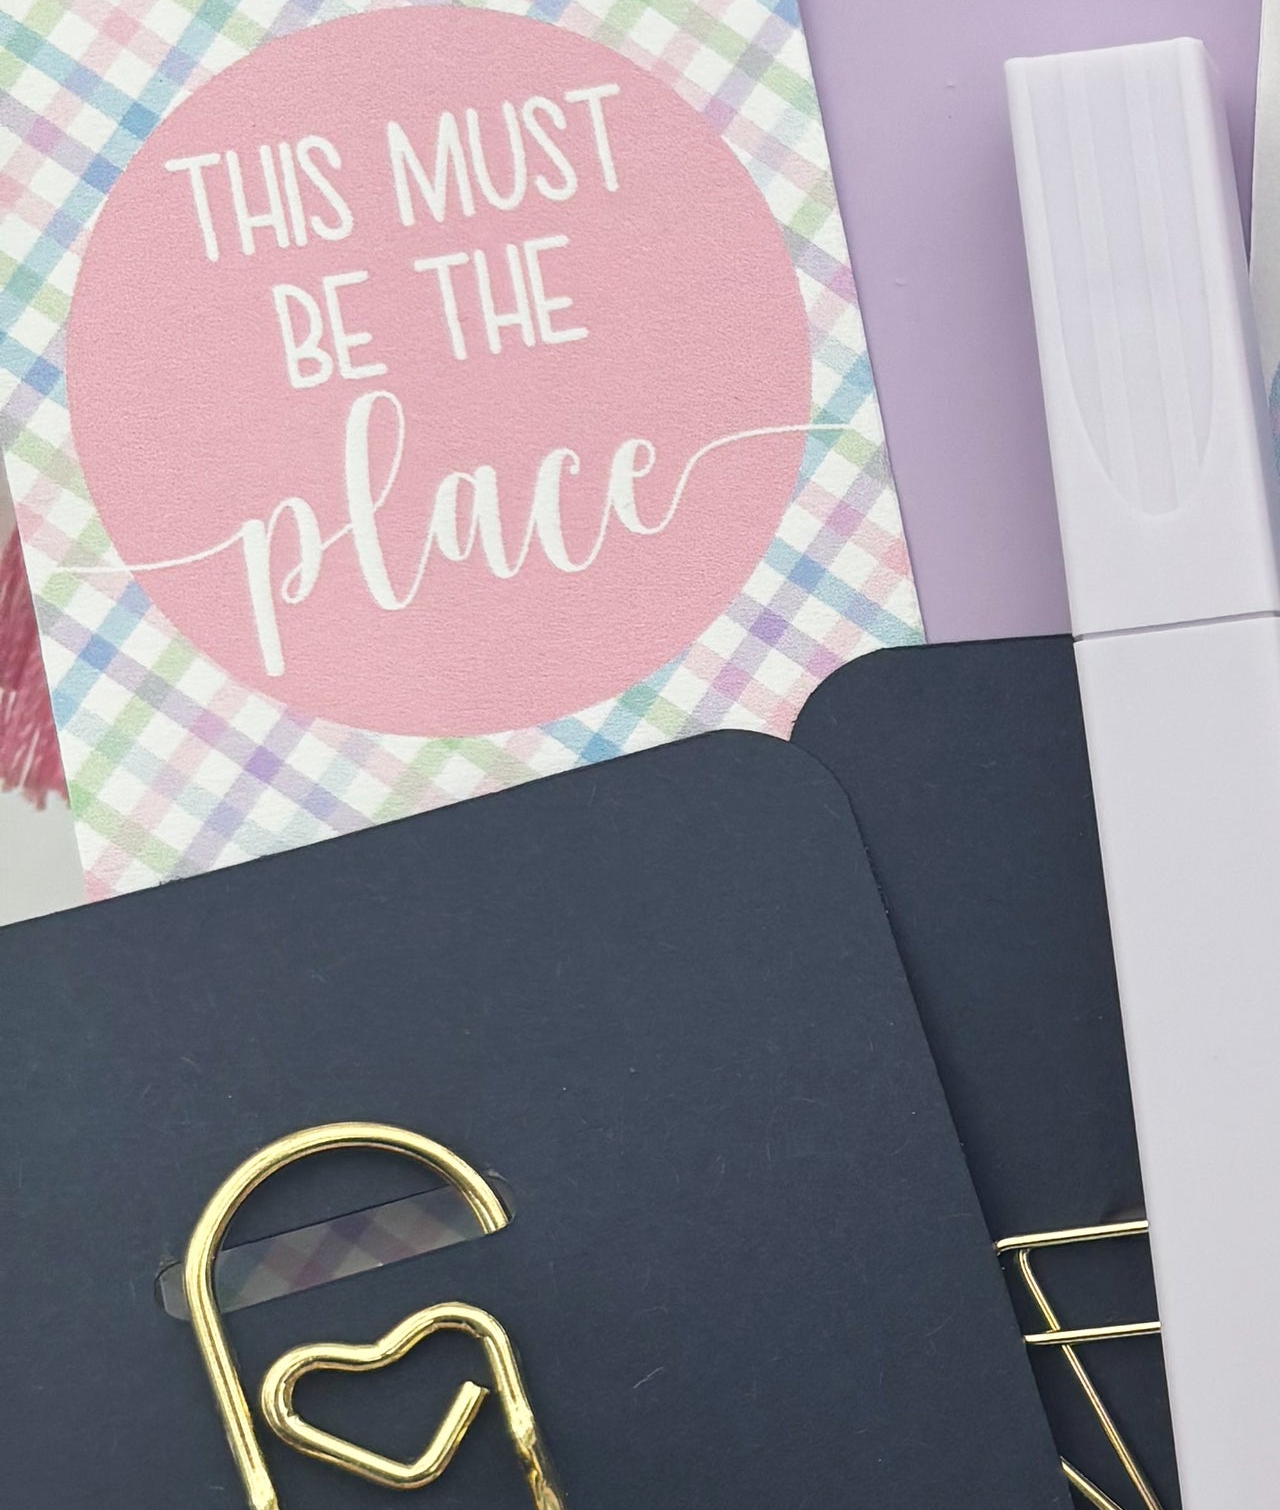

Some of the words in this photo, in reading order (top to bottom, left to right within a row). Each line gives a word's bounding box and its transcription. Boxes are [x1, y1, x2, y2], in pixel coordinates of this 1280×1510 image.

[164, 135, 354, 263] THIS
[386, 83, 620, 228] MUST
[272, 271, 388, 389] BE
[412, 234, 589, 362] THE
[56, 390, 856, 678] place
